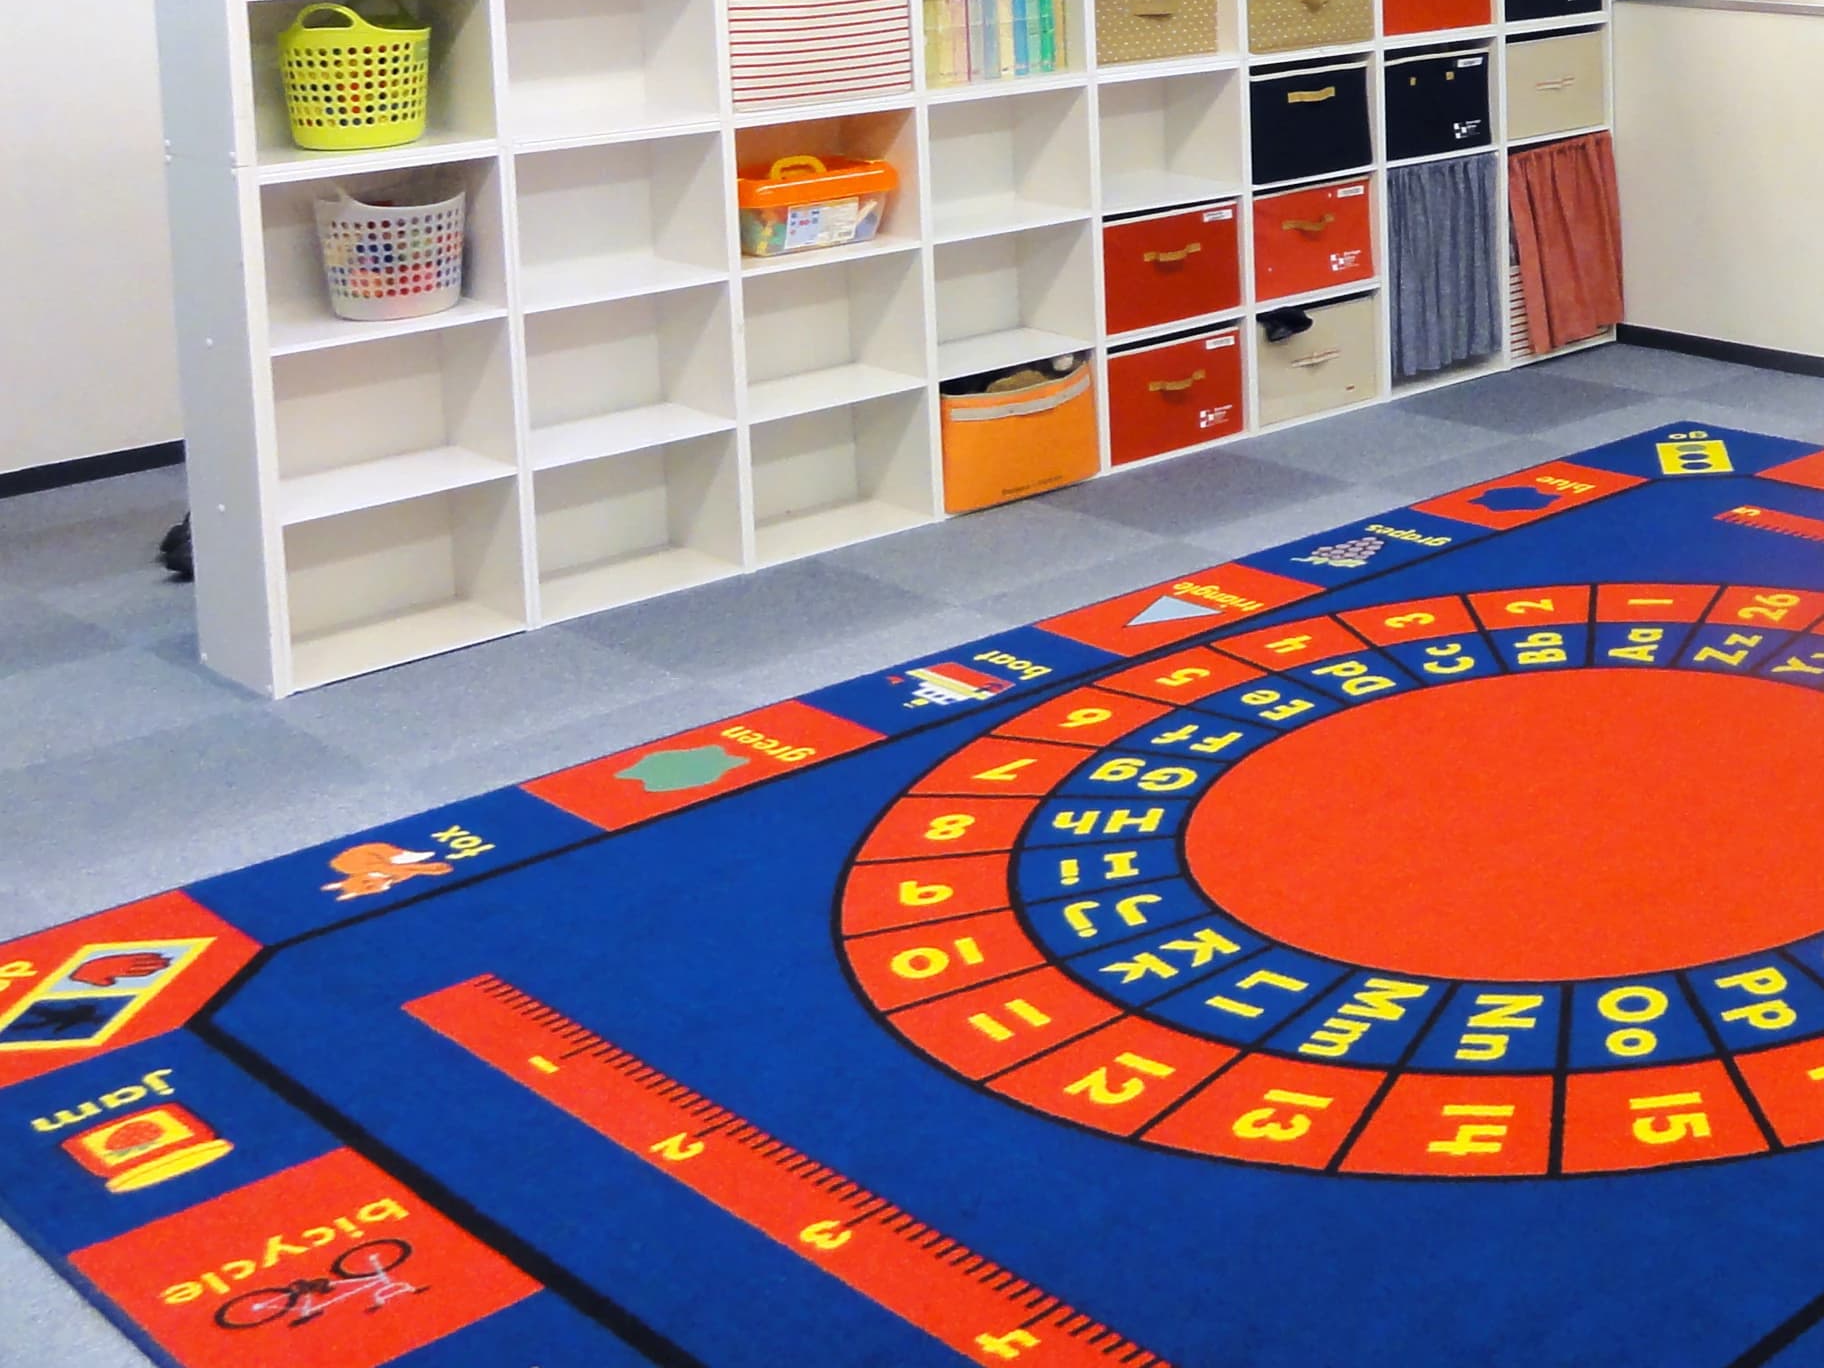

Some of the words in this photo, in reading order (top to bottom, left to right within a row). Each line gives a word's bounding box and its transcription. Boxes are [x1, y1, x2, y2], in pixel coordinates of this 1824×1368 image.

[1536, 477, 1595, 493] blue
[1366, 524, 1452, 548] grapes
[1172, 581, 1265, 614] triangle
[1505, 599, 1554, 614] 2
[1738, 594, 1800, 622] 26
[1385, 613, 1435, 628] 3
[1265, 635, 1312, 654] 4
[974, 651, 1052, 680] boat
[1155, 668, 1210, 686] 5
[1059, 708, 1112, 728] 6
[721, 725, 816, 763] green
[972, 759, 1037, 781] 7
[431, 825, 495, 859] fox
[924, 814, 975, 840] 8
[899, 881, 953, 906] 9
[890, 937, 984, 979] 10
[968, 999, 1051, 1042] 11
[1064, 1052, 1176, 1105] 12
[31, 1069, 175, 1132] jam
[1232, 1089, 1333, 1141] 13
[1427, 1105, 1515, 1156] 14
[1629, 1092, 1711, 1144] 15
[162, 1198, 411, 1305] bicycle
[650, 1133, 704, 1161] 2
[800, 1221, 852, 1250] 3
[975, 1330, 1040, 1359] 4
